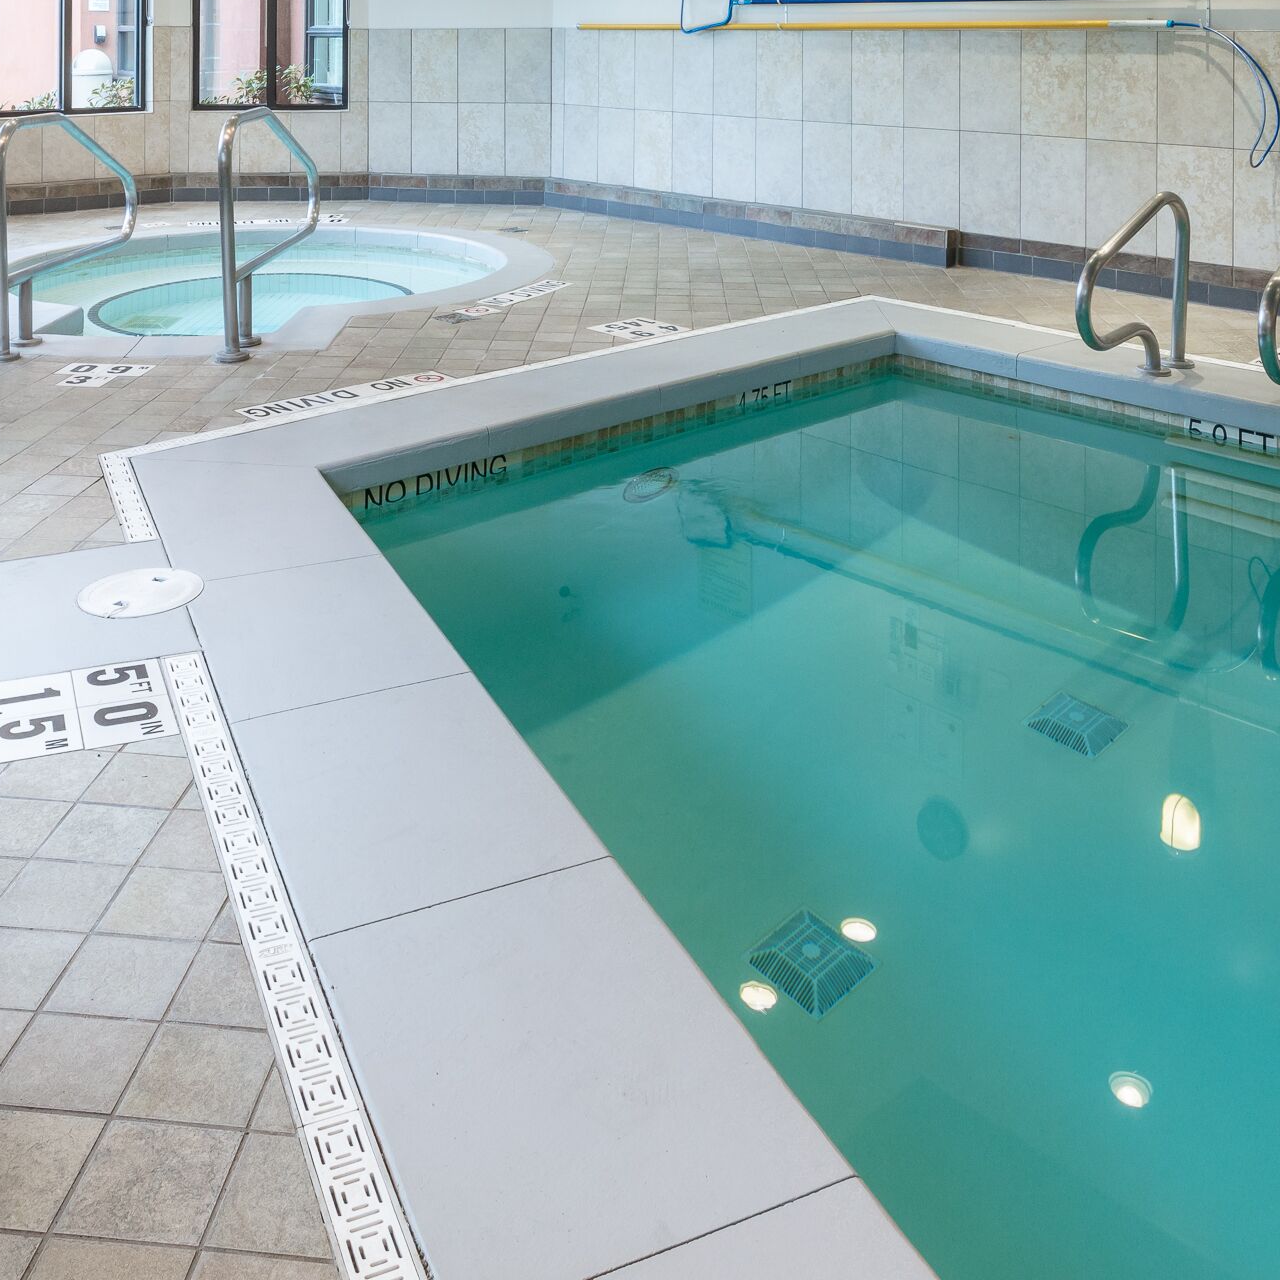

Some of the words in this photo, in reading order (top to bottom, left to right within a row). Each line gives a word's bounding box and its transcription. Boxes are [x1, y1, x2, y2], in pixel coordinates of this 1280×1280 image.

[370, 378, 412, 392] NO
[774, 380, 792, 402] FT
[242, 388, 360, 418] DIVING
[1238, 428, 1274, 452] FT
[364, 480, 406, 510] NO
[416, 454, 508, 496] DIVING
